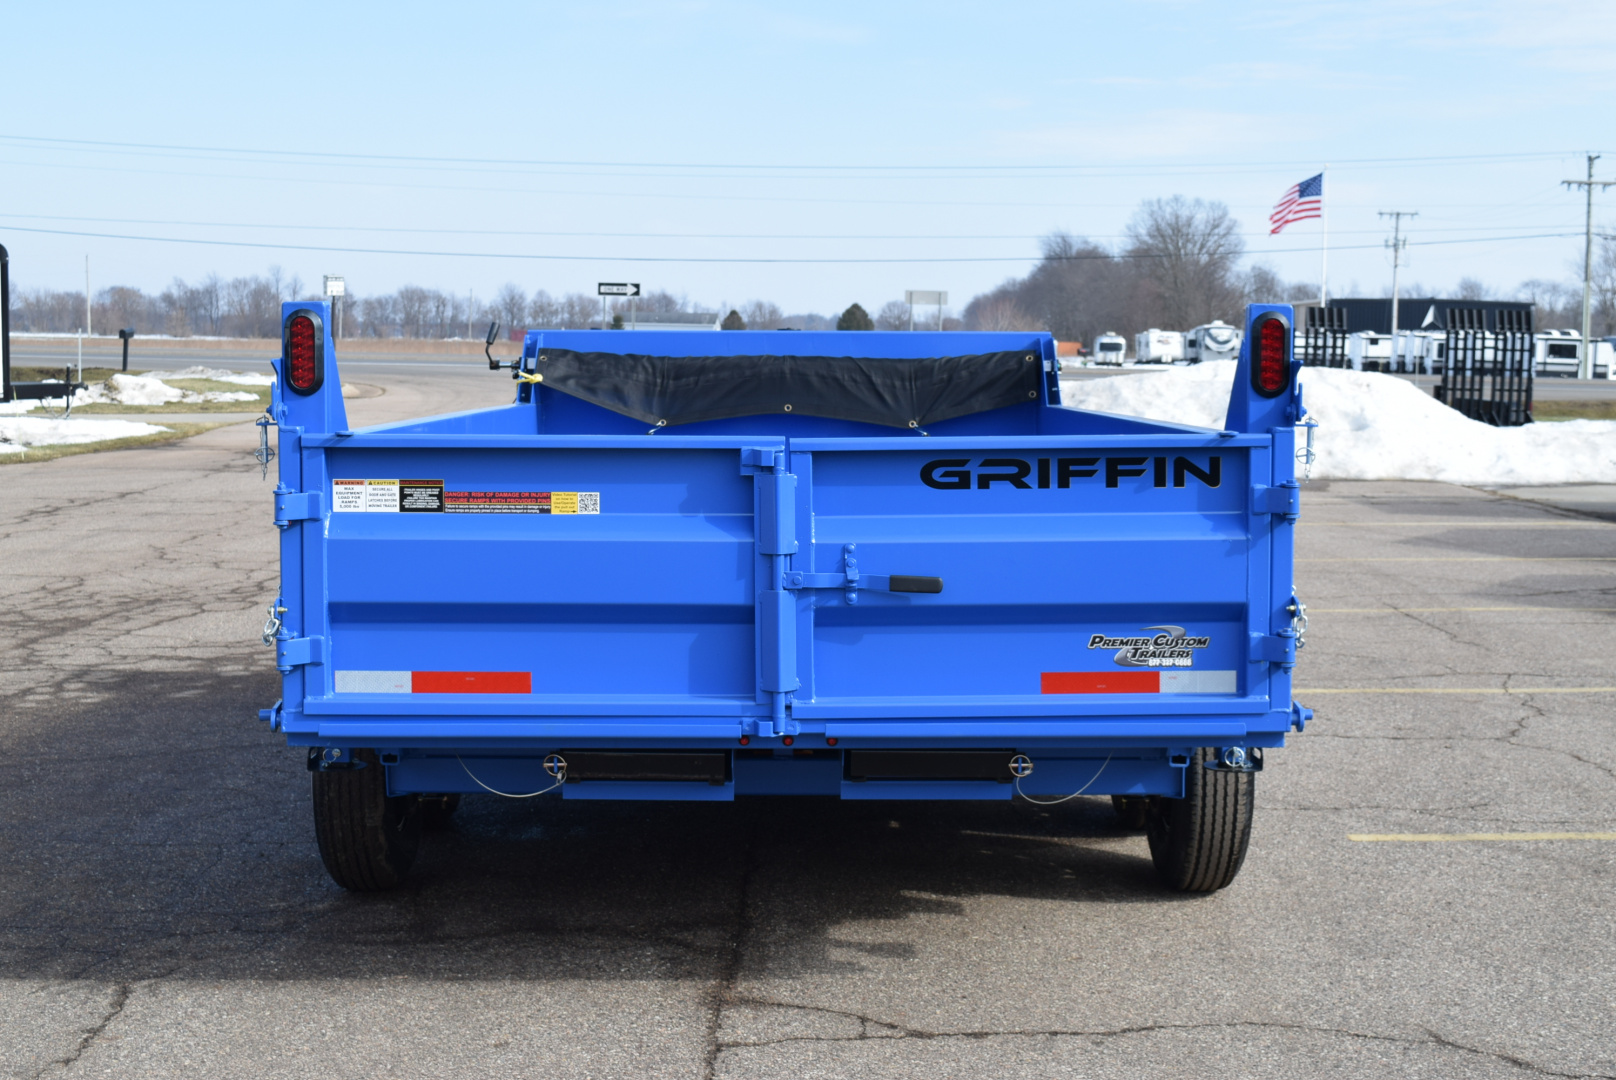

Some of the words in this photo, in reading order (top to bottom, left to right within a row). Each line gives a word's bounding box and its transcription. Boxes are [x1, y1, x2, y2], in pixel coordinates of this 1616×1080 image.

[920, 456, 1222, 490] GRIFFIN
[1088, 635, 1150, 648] PREMIER
[1153, 635, 1209, 648] CUSTOM
[1131, 648, 1192, 658] TRAILERS
